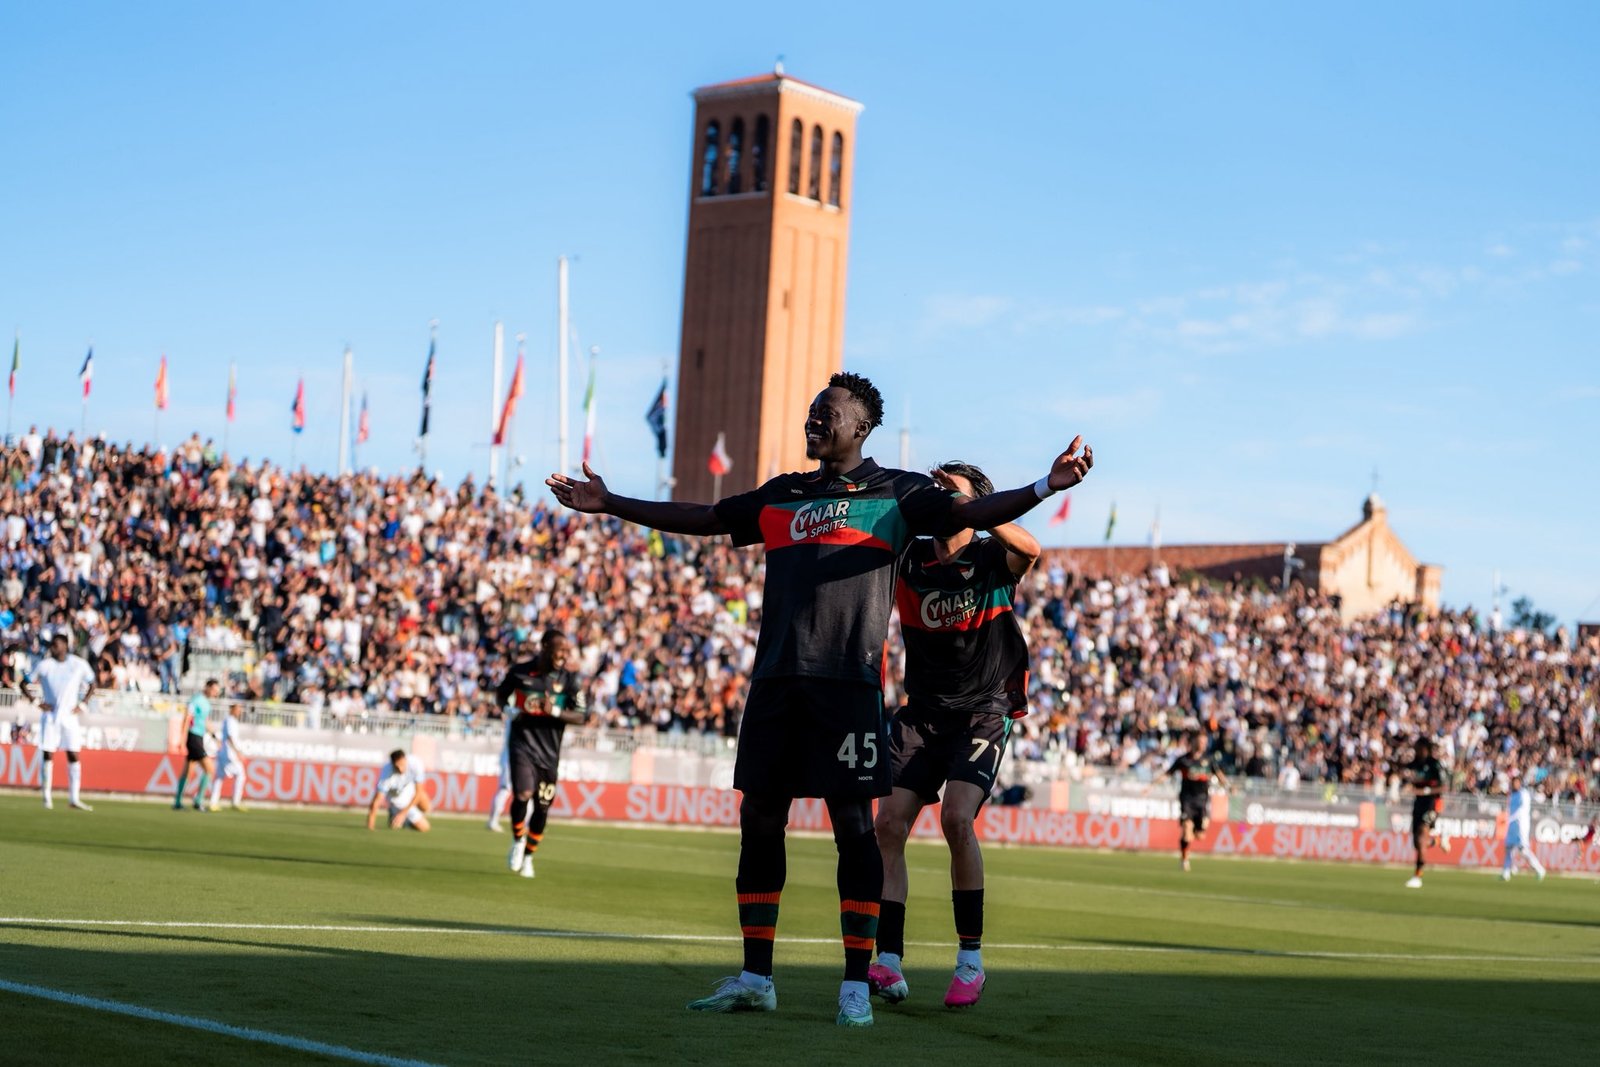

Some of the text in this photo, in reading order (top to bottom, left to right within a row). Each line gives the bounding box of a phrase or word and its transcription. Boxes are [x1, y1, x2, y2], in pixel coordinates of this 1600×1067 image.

[790, 500, 850, 541] CYNAR
[810, 518, 848, 538] SPRITZ
[920, 588, 975, 628] CYNAR
[945, 605, 977, 627] SPRITZ
[836, 732, 878, 769] 45
[968, 738, 1001, 775] 71
[982, 807, 1149, 849] SUN68.COM
